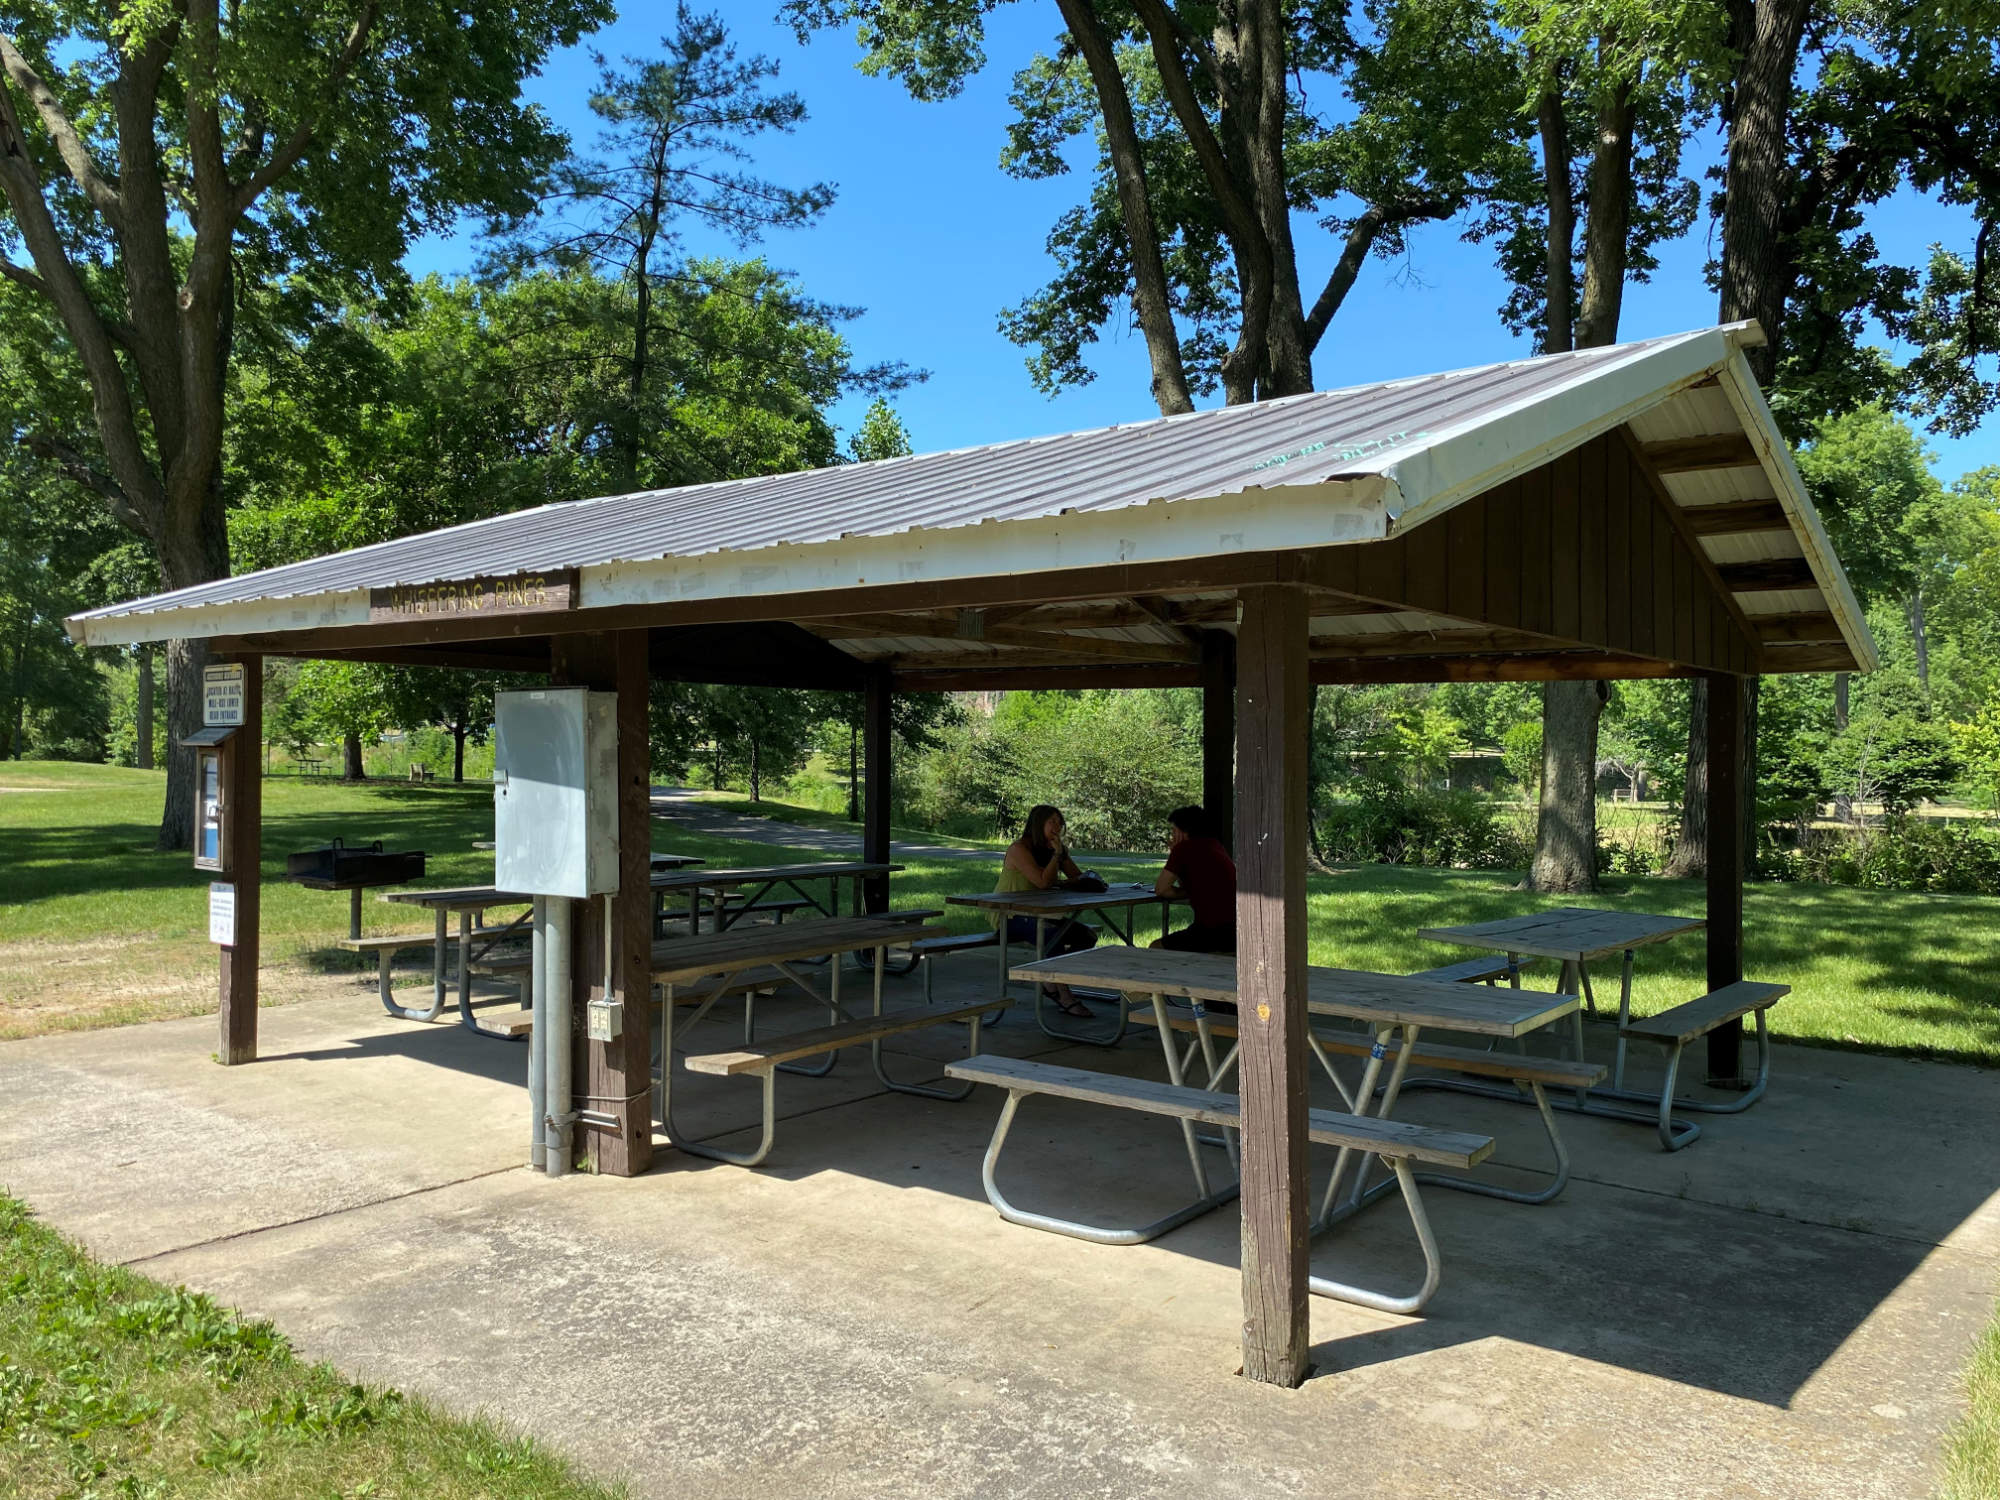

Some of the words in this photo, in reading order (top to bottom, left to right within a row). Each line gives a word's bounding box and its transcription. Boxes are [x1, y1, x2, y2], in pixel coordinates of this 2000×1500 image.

[391, 582, 484, 615] WHISPERING
[494, 576, 546, 609] PINES
[220, 709, 238, 720] ENTRANCE
